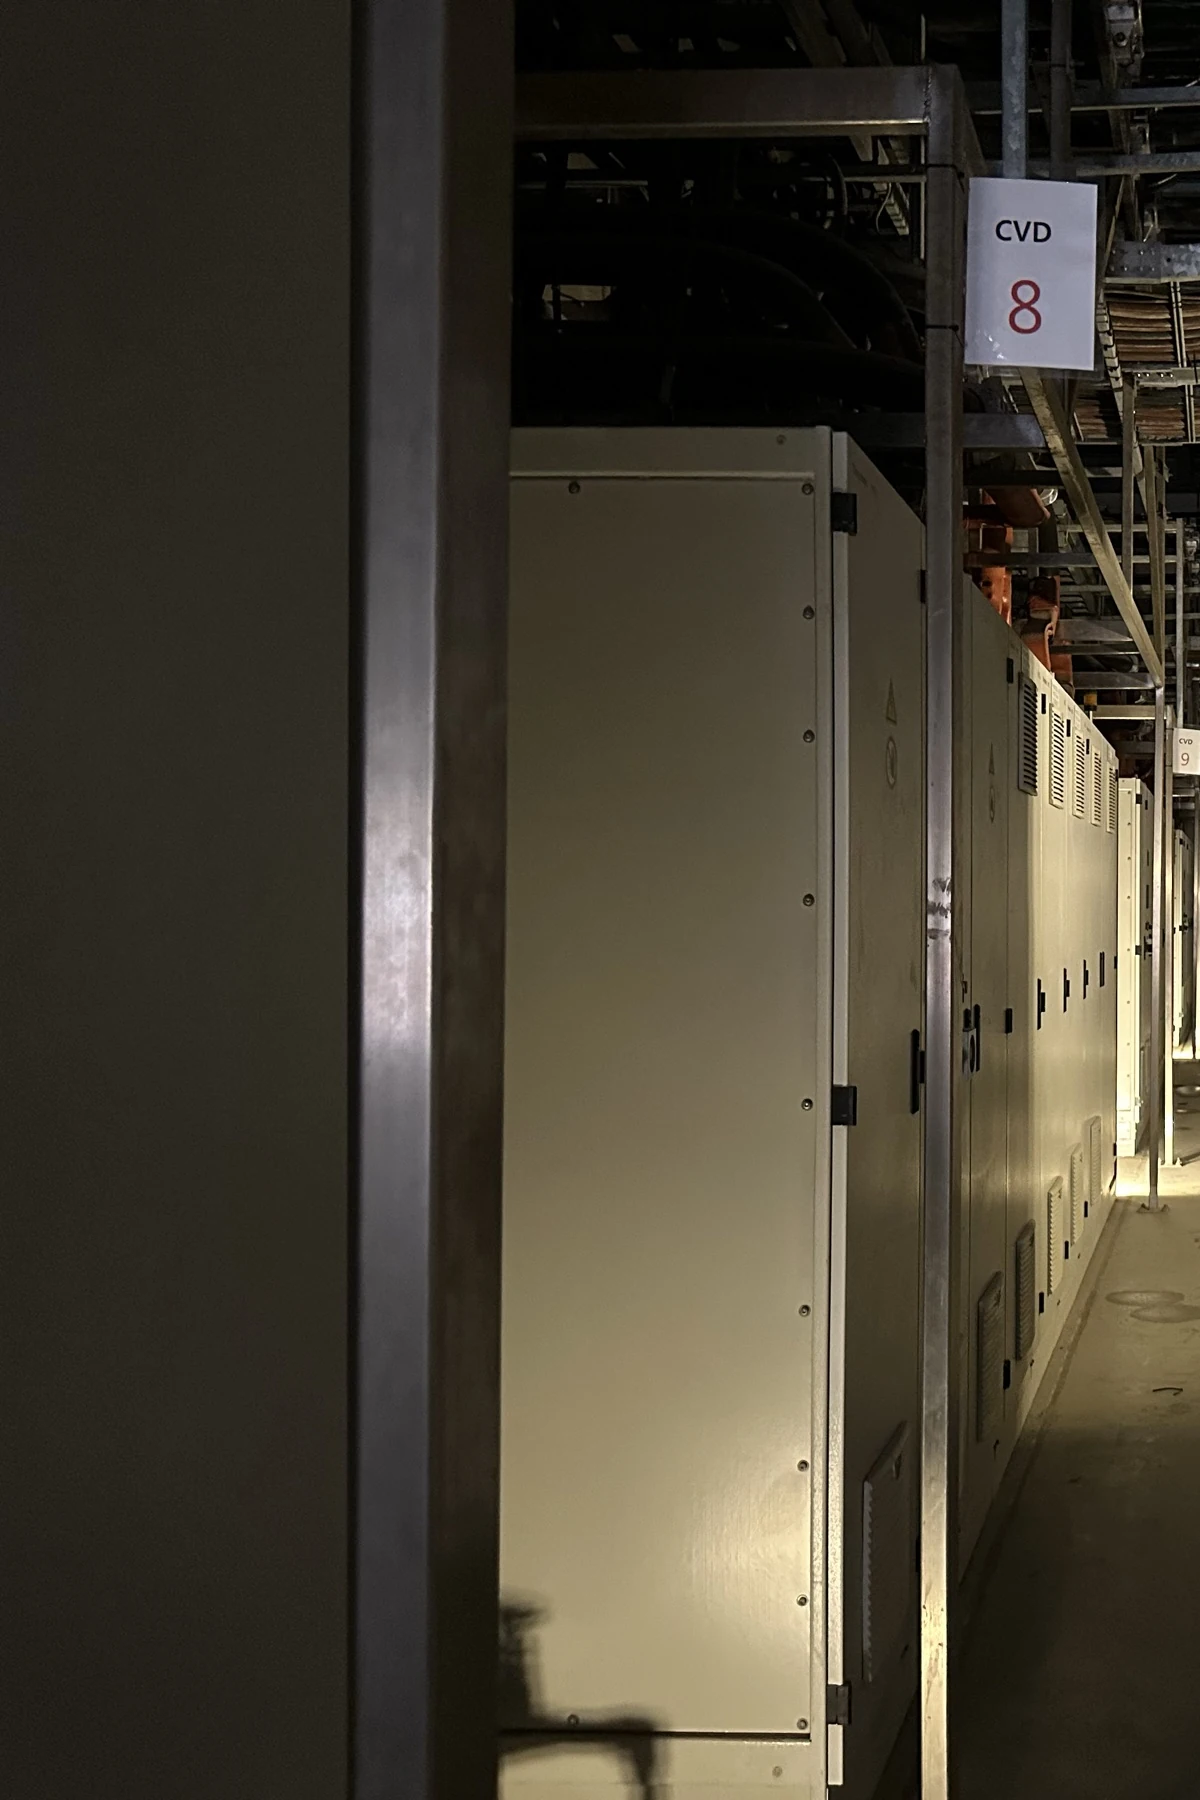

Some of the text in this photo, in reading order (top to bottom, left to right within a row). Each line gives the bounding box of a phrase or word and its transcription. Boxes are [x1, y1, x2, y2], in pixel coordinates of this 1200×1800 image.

[995, 219, 1052, 243] CVD
[1008, 279, 1042, 335] 8
[1178, 737, 1193, 745] CVD
[1181, 752, 1190, 766] 9
